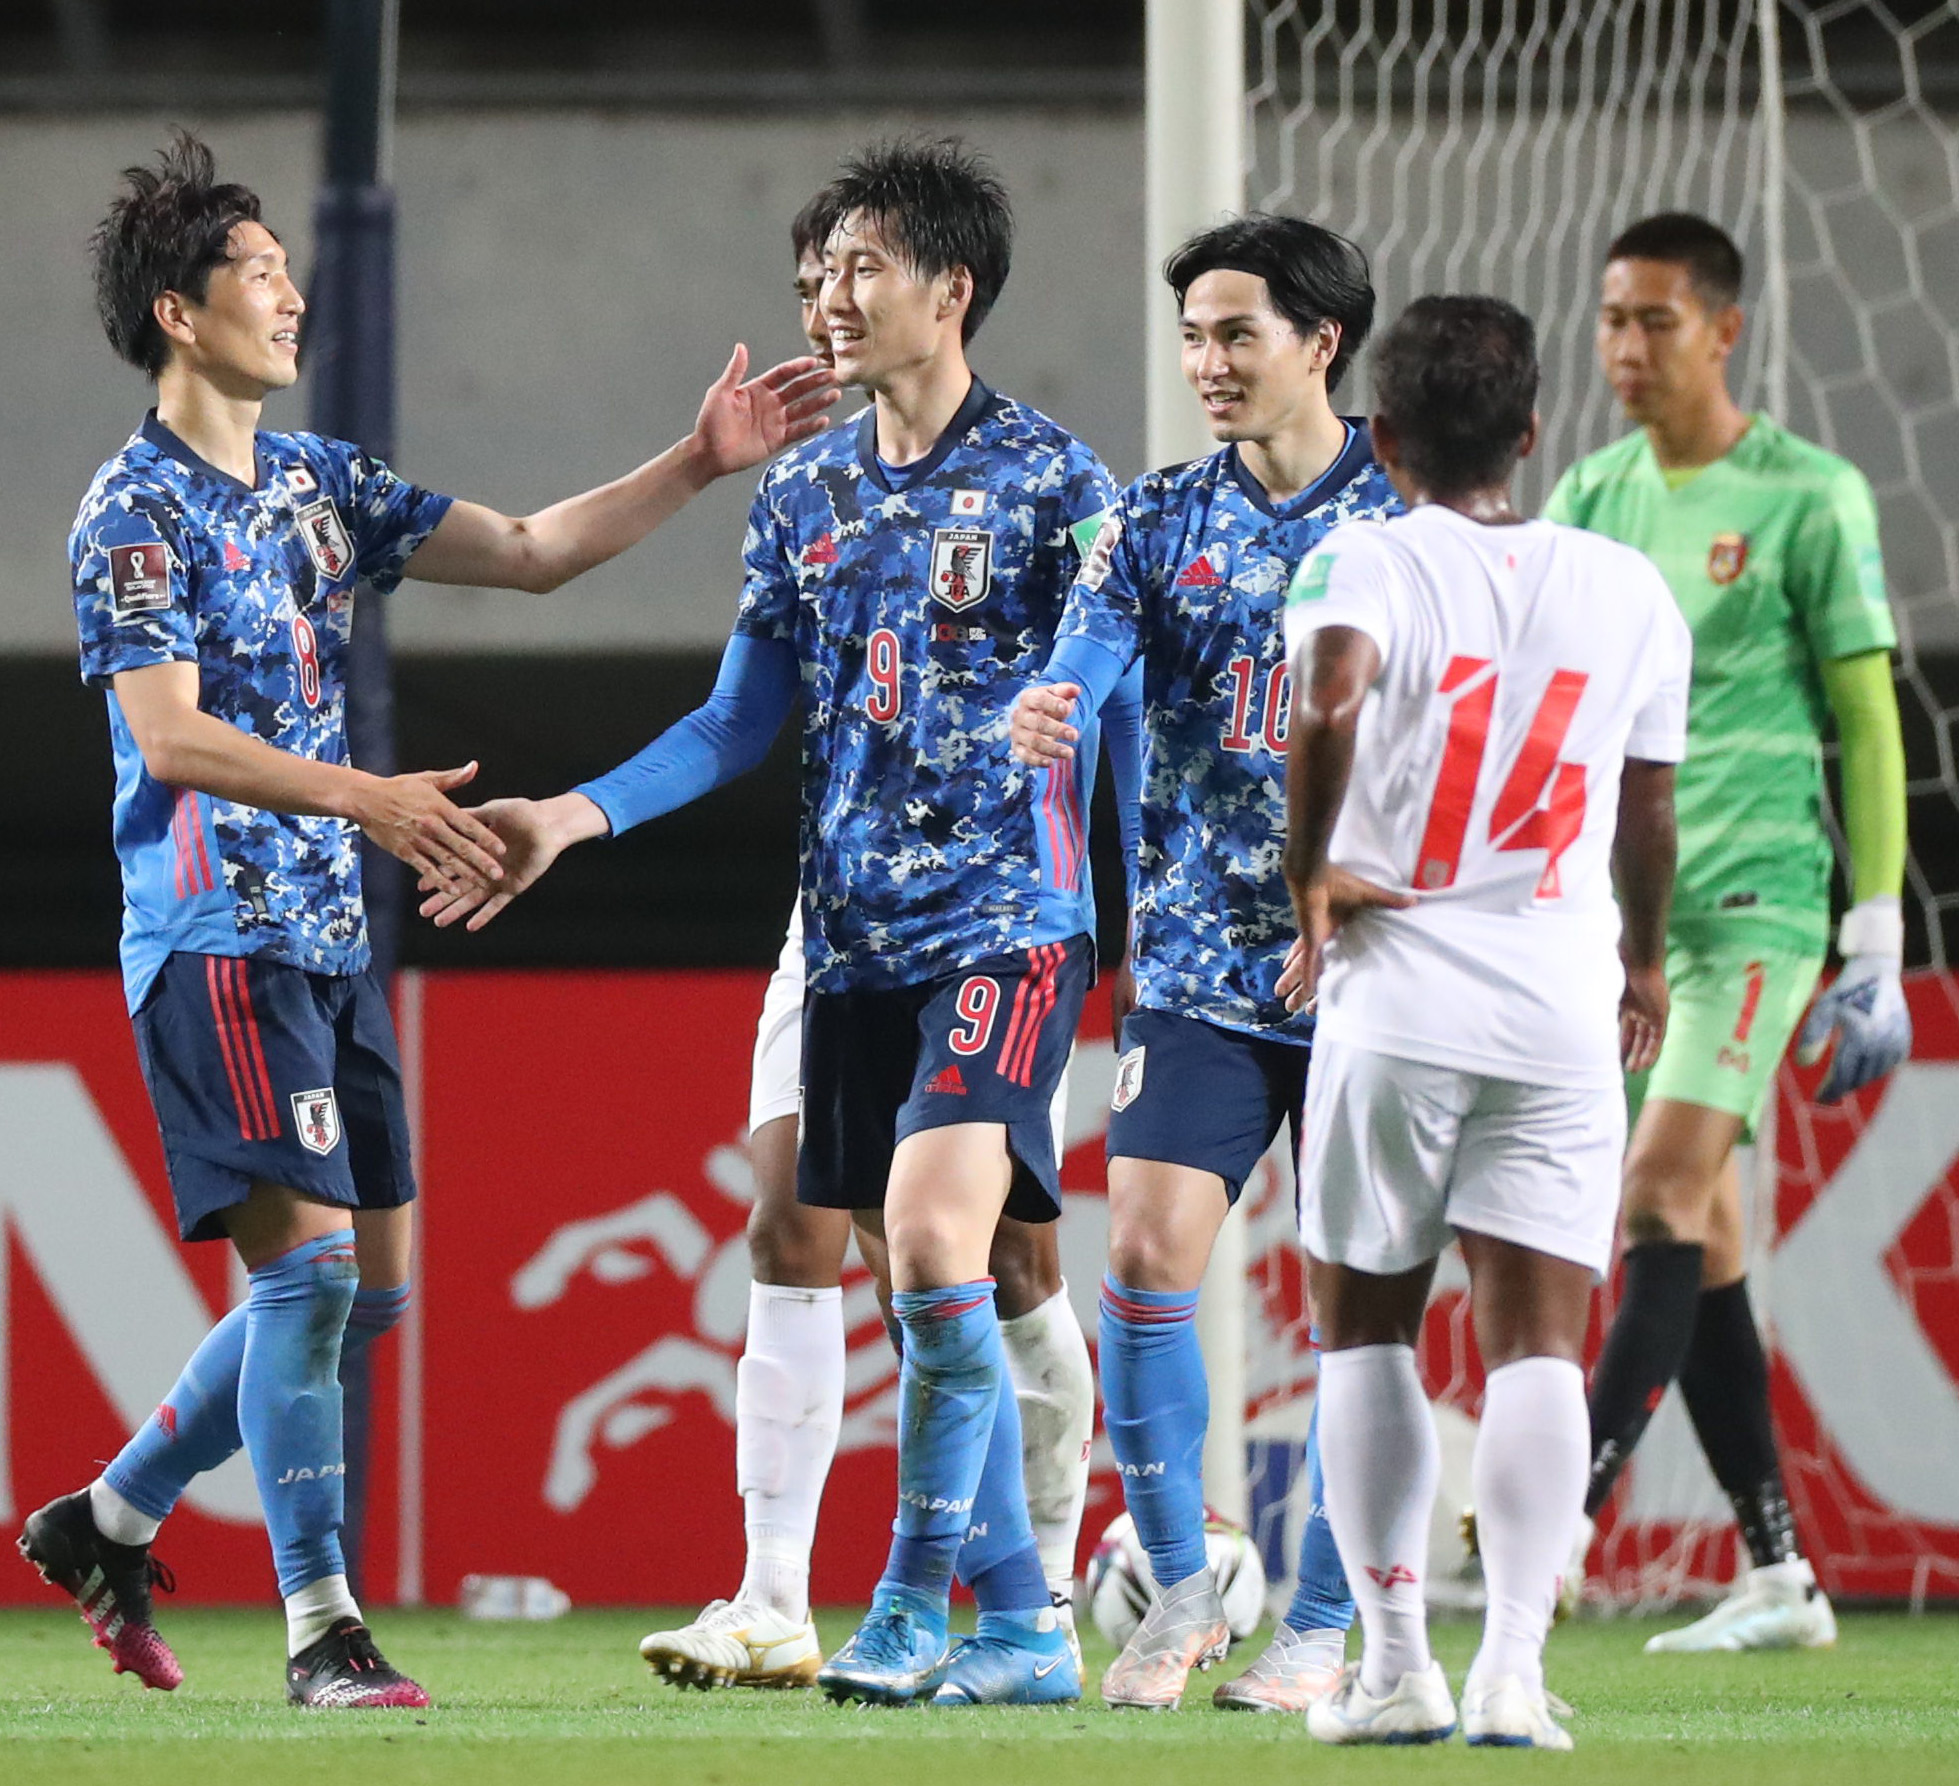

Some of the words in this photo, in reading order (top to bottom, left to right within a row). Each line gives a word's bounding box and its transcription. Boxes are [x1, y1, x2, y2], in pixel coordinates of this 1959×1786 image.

[948, 533, 978, 541] JAPAN
[292, 614, 320, 708] 8
[866, 628, 900, 725] 9
[1410, 654, 1590, 898] 14
[948, 975, 1001, 1056] 9
[1732, 961, 1765, 1042] 1
[900, 1490, 975, 1514] JAPAN
